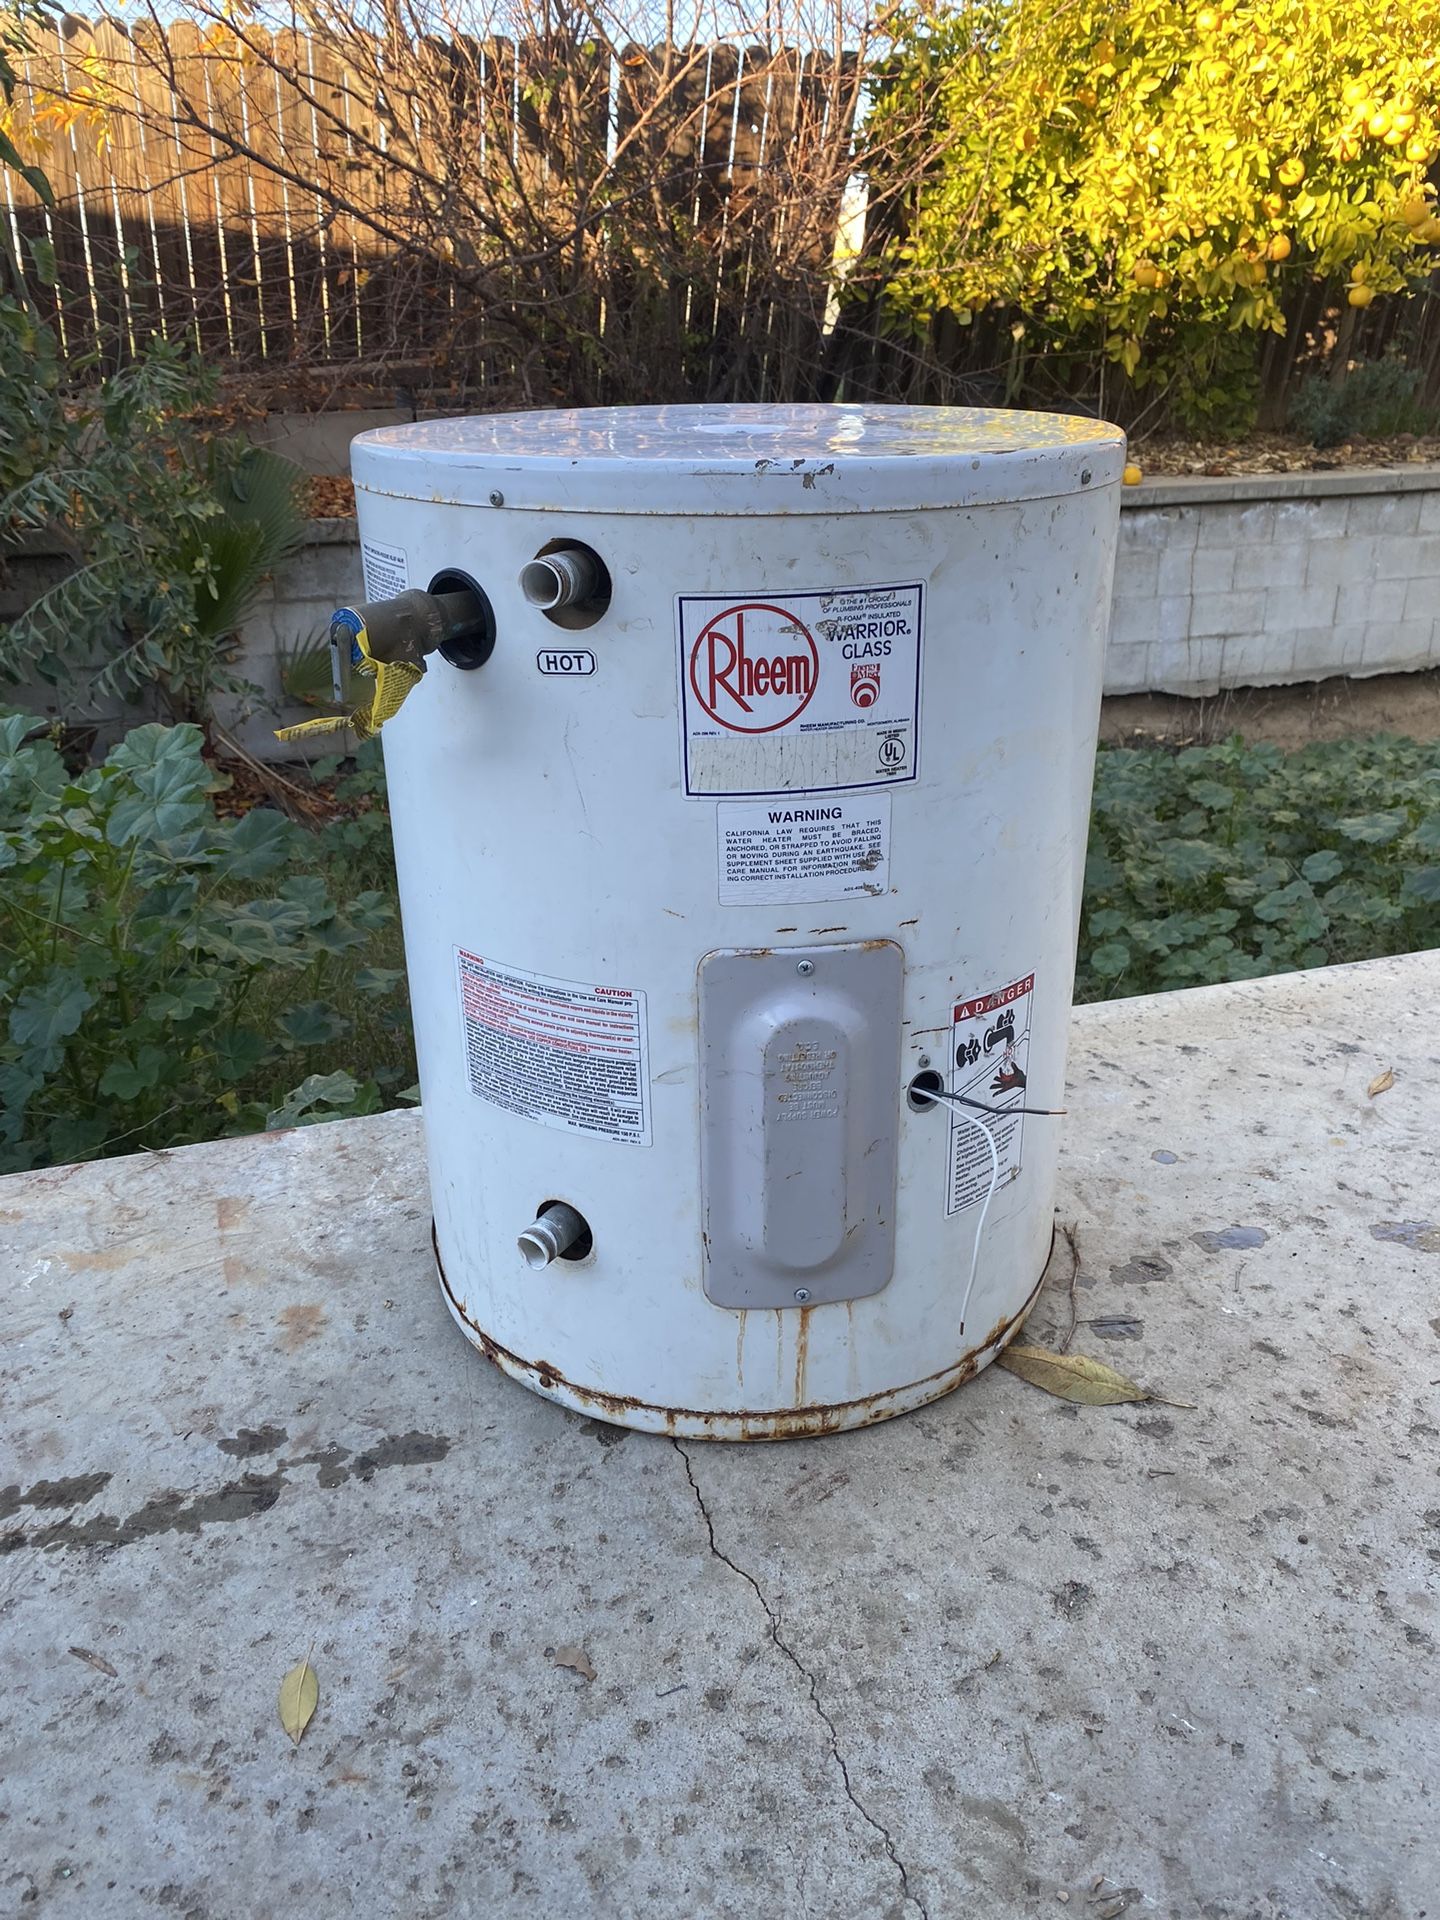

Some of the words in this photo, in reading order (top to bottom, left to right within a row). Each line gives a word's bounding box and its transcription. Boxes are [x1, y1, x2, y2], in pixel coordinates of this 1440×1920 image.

[832, 604, 864, 612] PLUMBING
[865, 600, 912, 610] PROFESSIONALS
[868, 611, 901, 619] INSULATED
[842, 640, 892, 659] GLASS
[546, 655, 584, 671] HOT
[707, 612, 810, 712] Rheem
[768, 807, 842, 824] WARNING
[799, 825, 835, 833] REQUIRES
[842, 822, 860, 830] THAT
[781, 841, 818, 850] STRAPPED
[832, 838, 852, 846] AVOID
[854, 834, 882, 843] FALLING
[816, 844, 865, 855] EARTHQUAKE.
[726, 860, 772, 868] SUPPLEMENT
[799, 855, 832, 864] SUPPLIED
[834, 852, 851, 860] WITH
[801, 861, 849, 871] INFORMATION
[852, 857, 884, 866] REARD-
[740, 874, 773, 882] CORRECT
[774, 870, 824, 880] INSTALLATION
[826, 867, 869, 875] PROCEDURE
[594, 987, 632, 998] CAUTION
